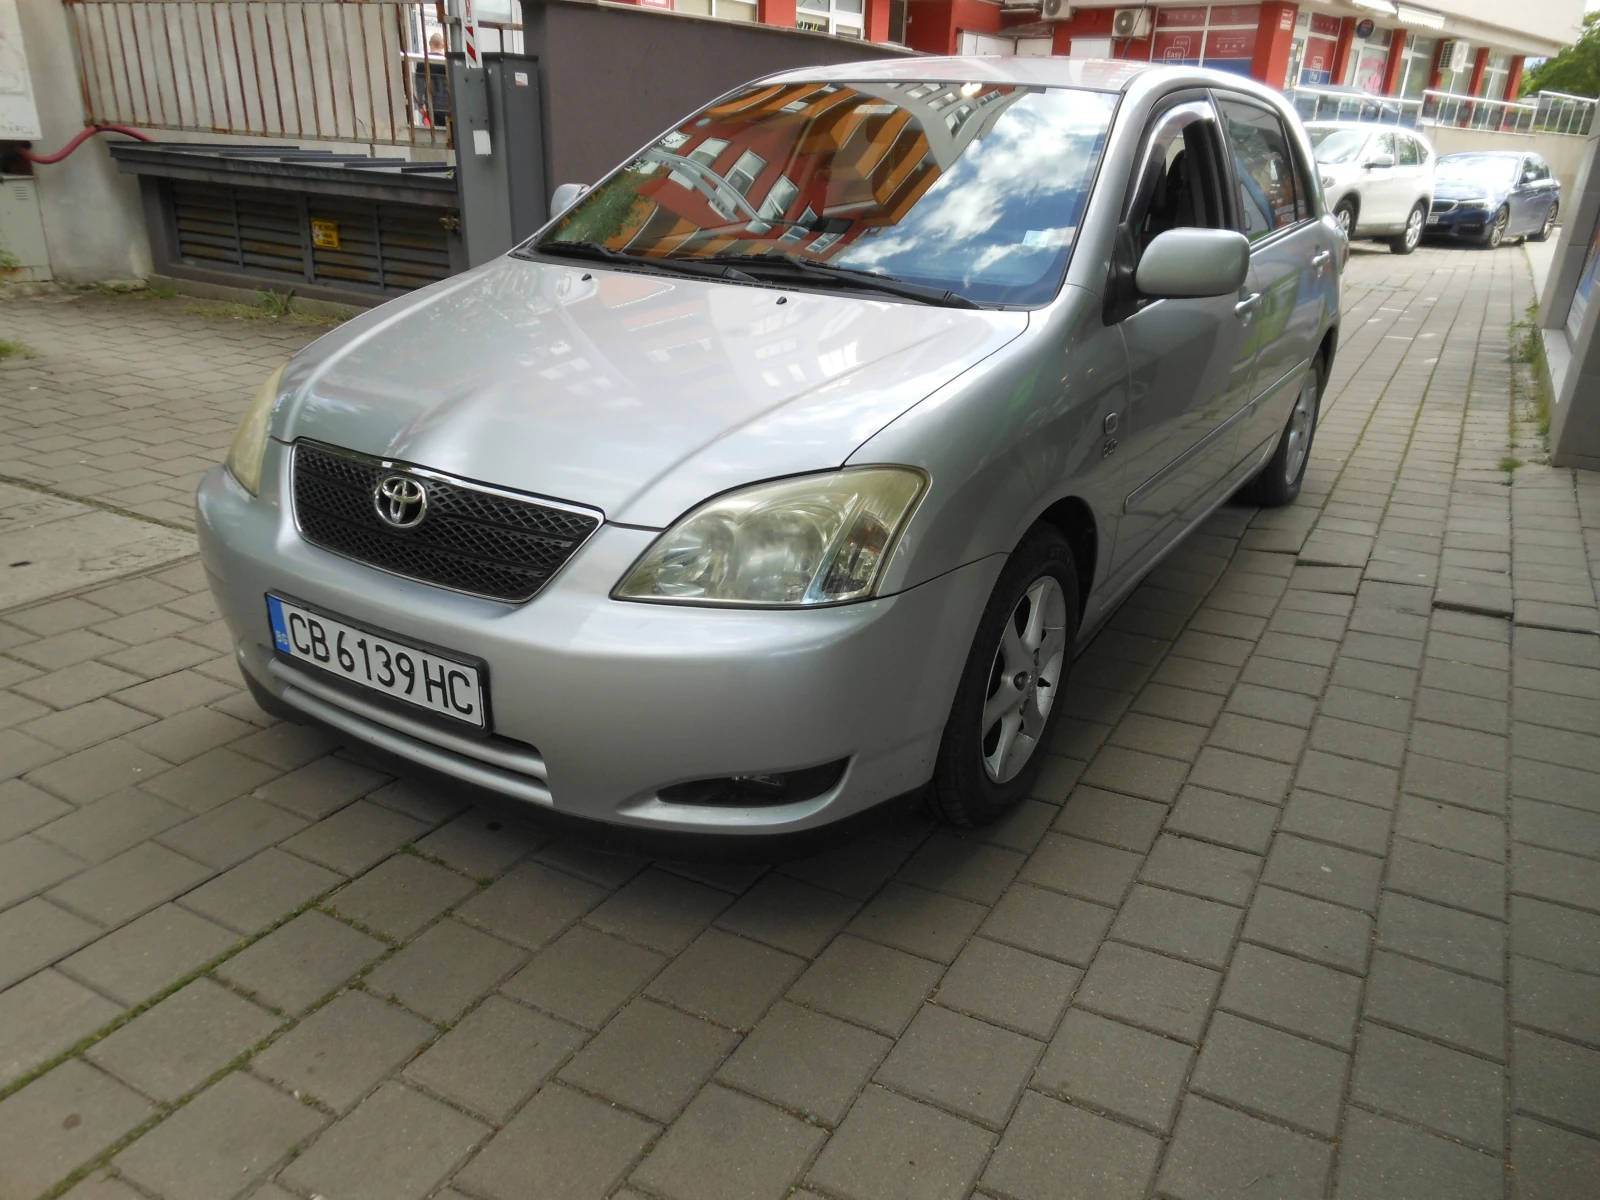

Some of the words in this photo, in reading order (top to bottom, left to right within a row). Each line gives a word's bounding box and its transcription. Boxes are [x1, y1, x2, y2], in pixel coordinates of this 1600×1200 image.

[1166, 50, 1183, 60] Easy
[276, 629, 288, 645] BG
[289, 613, 330, 663] CB
[338, 631, 415, 695] 6139
[422, 659, 473, 716] HC
